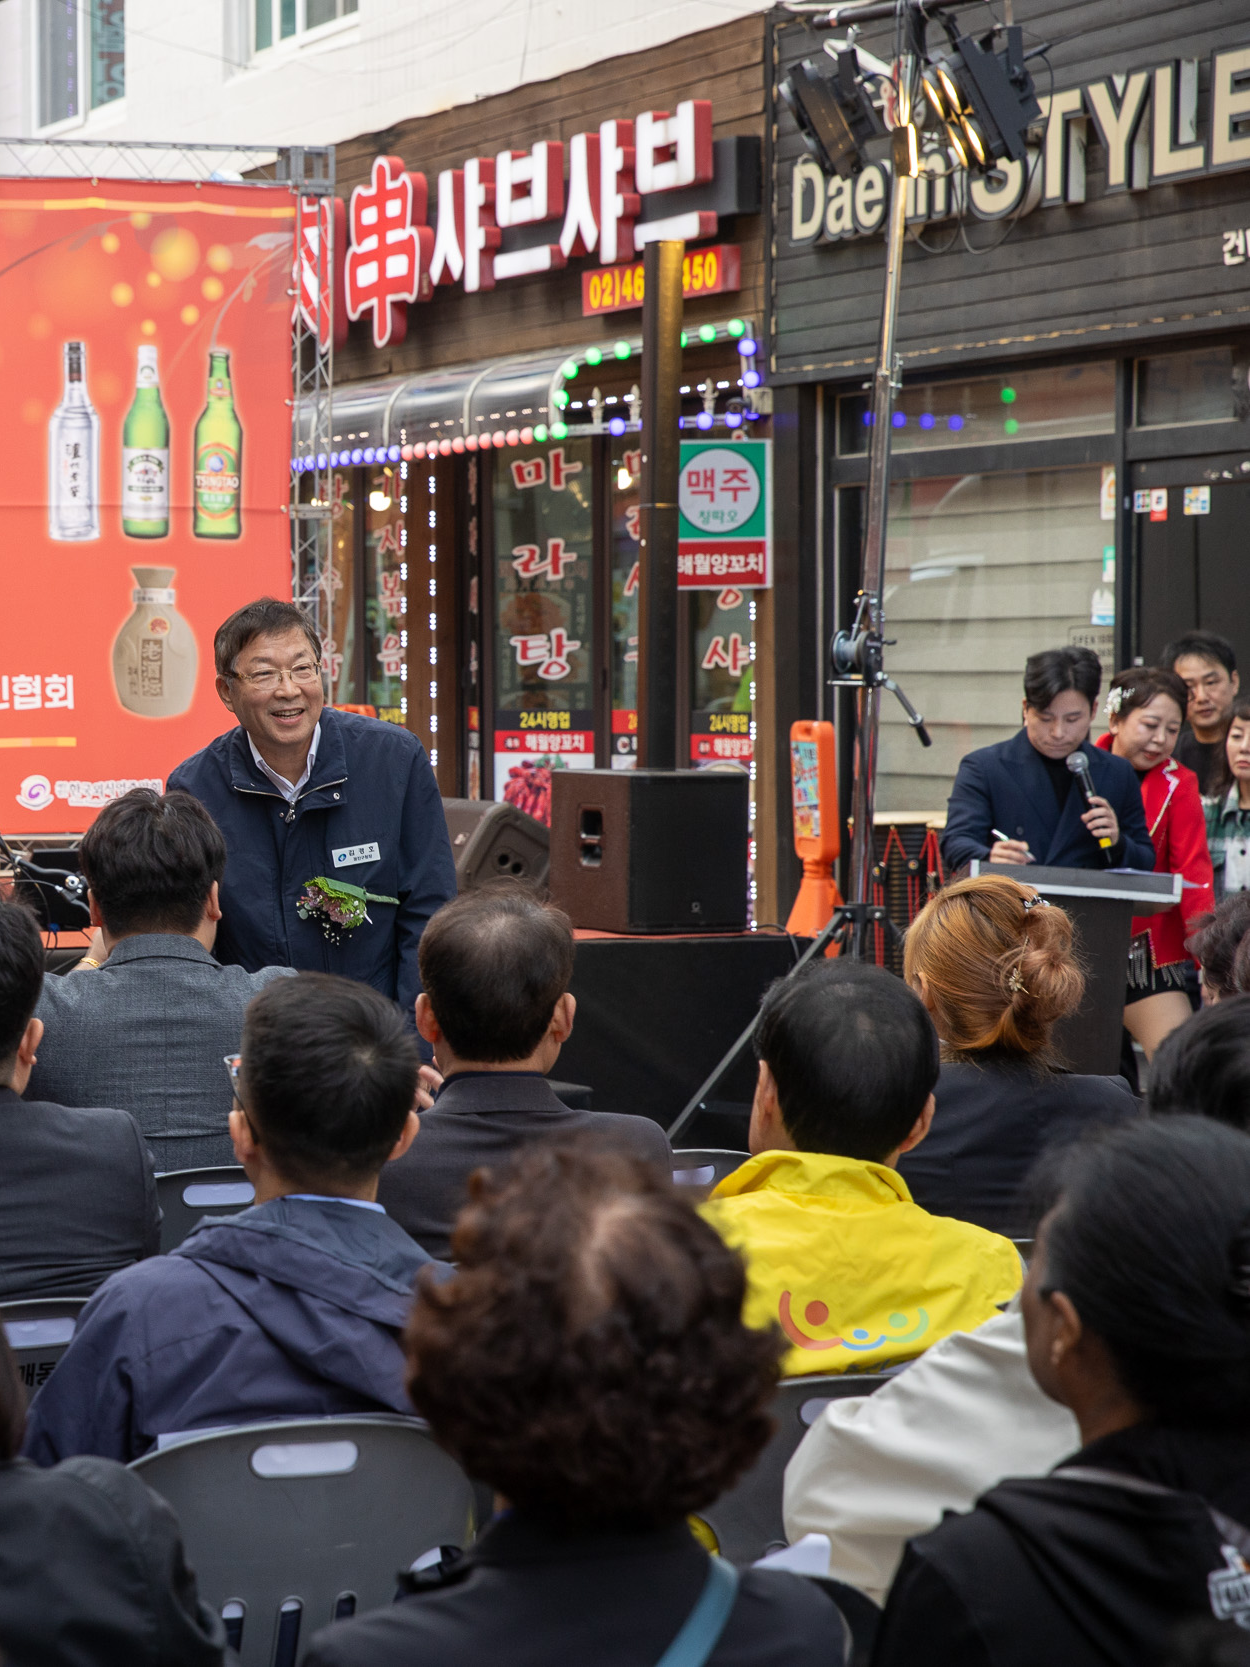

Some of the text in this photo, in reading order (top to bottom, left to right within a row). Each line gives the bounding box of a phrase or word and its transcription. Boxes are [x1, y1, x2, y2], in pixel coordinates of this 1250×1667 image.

[970, 48, 1250, 215] STYLE
[429, 99, 714, 293] 샤브샤브
[686, 468, 751, 503] 맥주
[510, 448, 583, 680] 마라탕
[677, 553, 764, 576] 해월양꼬치
[519, 711, 571, 730] 24시영업
[525, 732, 585, 752] 해월양꼬치
